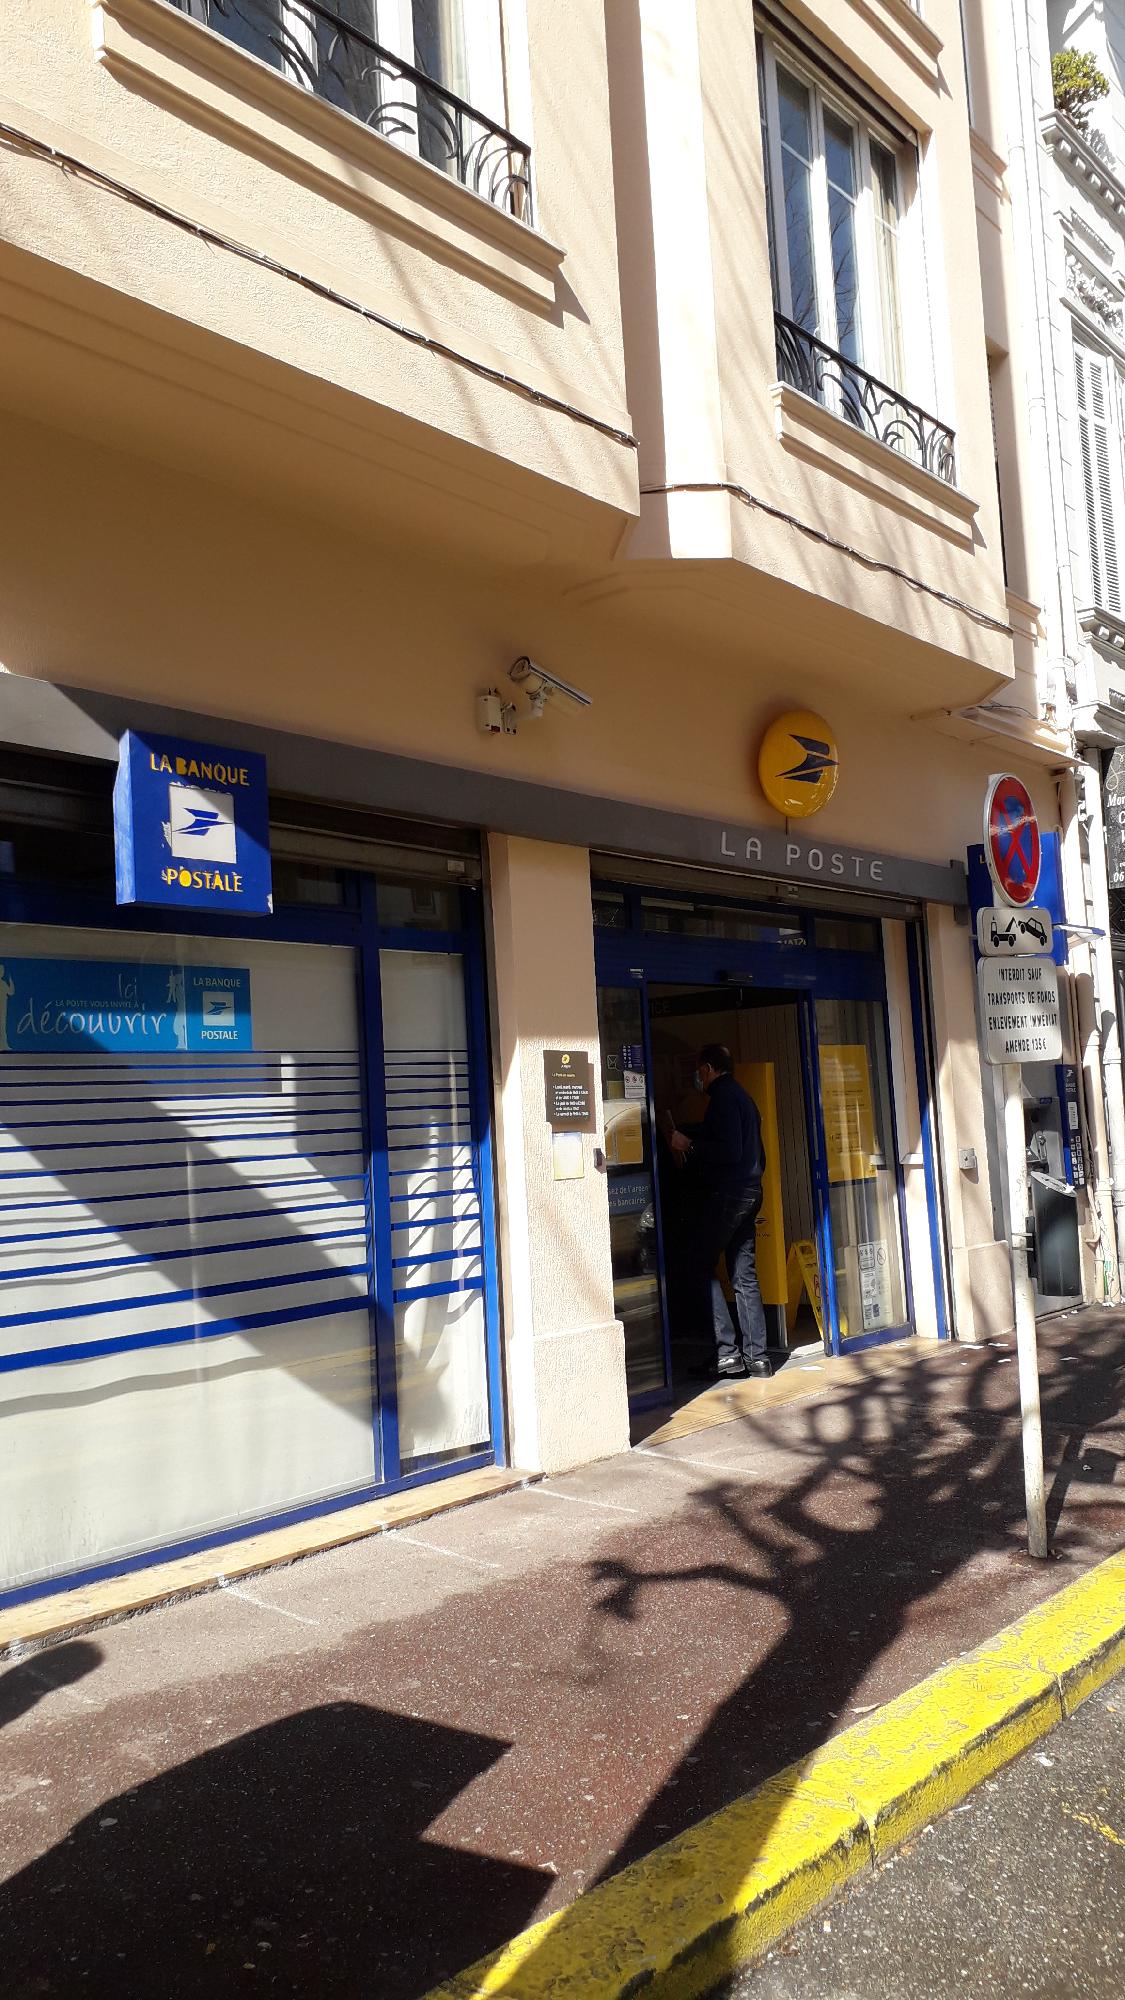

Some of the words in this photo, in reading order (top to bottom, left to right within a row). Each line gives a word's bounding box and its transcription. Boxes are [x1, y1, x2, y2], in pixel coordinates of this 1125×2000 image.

[150, 752, 173, 774] LA
[175, 756, 250, 787] BANQUE
[720, 831, 762, 861] LA
[786, 844, 883, 881] POSTE
[166, 866, 244, 893] POSTALE
[998, 967, 1025, 981] INTERDIT
[1027, 967, 1042, 980] SAUF
[118, 973, 137, 1000] Ici
[193, 977, 204, 987] LA
[205, 977, 241, 989] BANQUE
[987, 992, 1026, 1006] TRANSPORTS
[1027, 991, 1035, 1004] DE
[1037, 990, 1056, 1003] FONDS
[17, 998, 167, 1035] découvrir
[988, 1015, 1028, 1030] ENLEVEMENT
[201, 1030, 239, 1040] POSTALE
[1005, 1039, 1030, 1054] AMENDE
